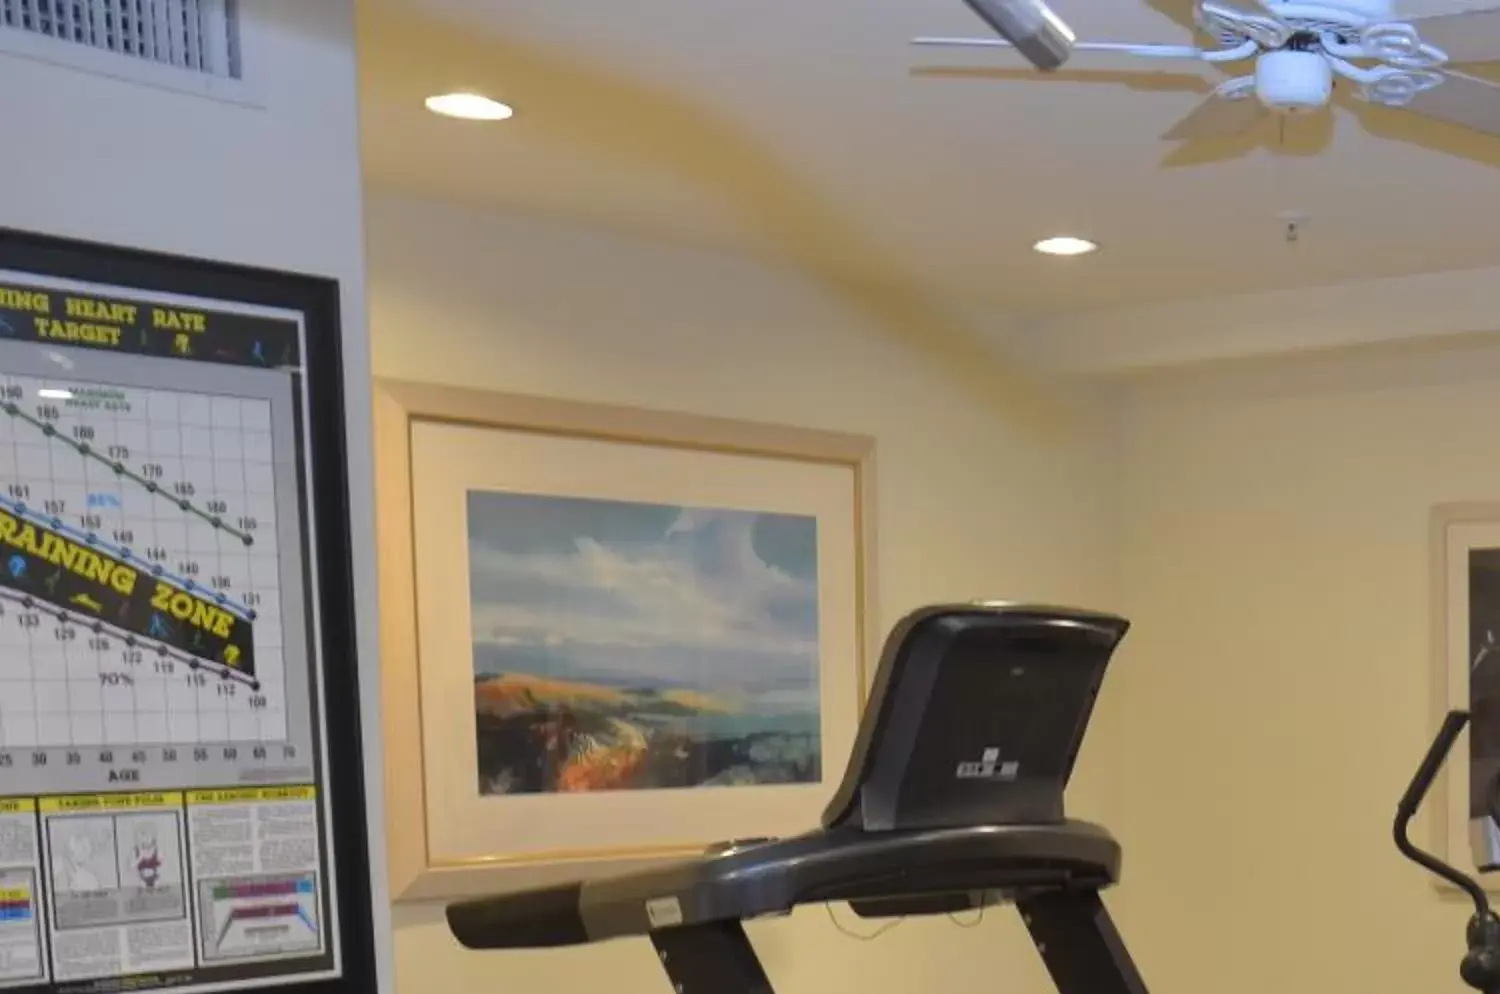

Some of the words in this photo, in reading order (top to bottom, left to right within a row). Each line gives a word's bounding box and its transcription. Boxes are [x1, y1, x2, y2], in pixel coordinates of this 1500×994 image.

[66, 297, 137, 324] HEART
[152, 308, 206, 332] RATE
[34, 317, 121, 345] TARGET
[142, 464, 163, 477] 170
[151, 583, 235, 639] ZONE
[99, 673, 134, 686] 70%
[108, 770, 140, 783] AGE
